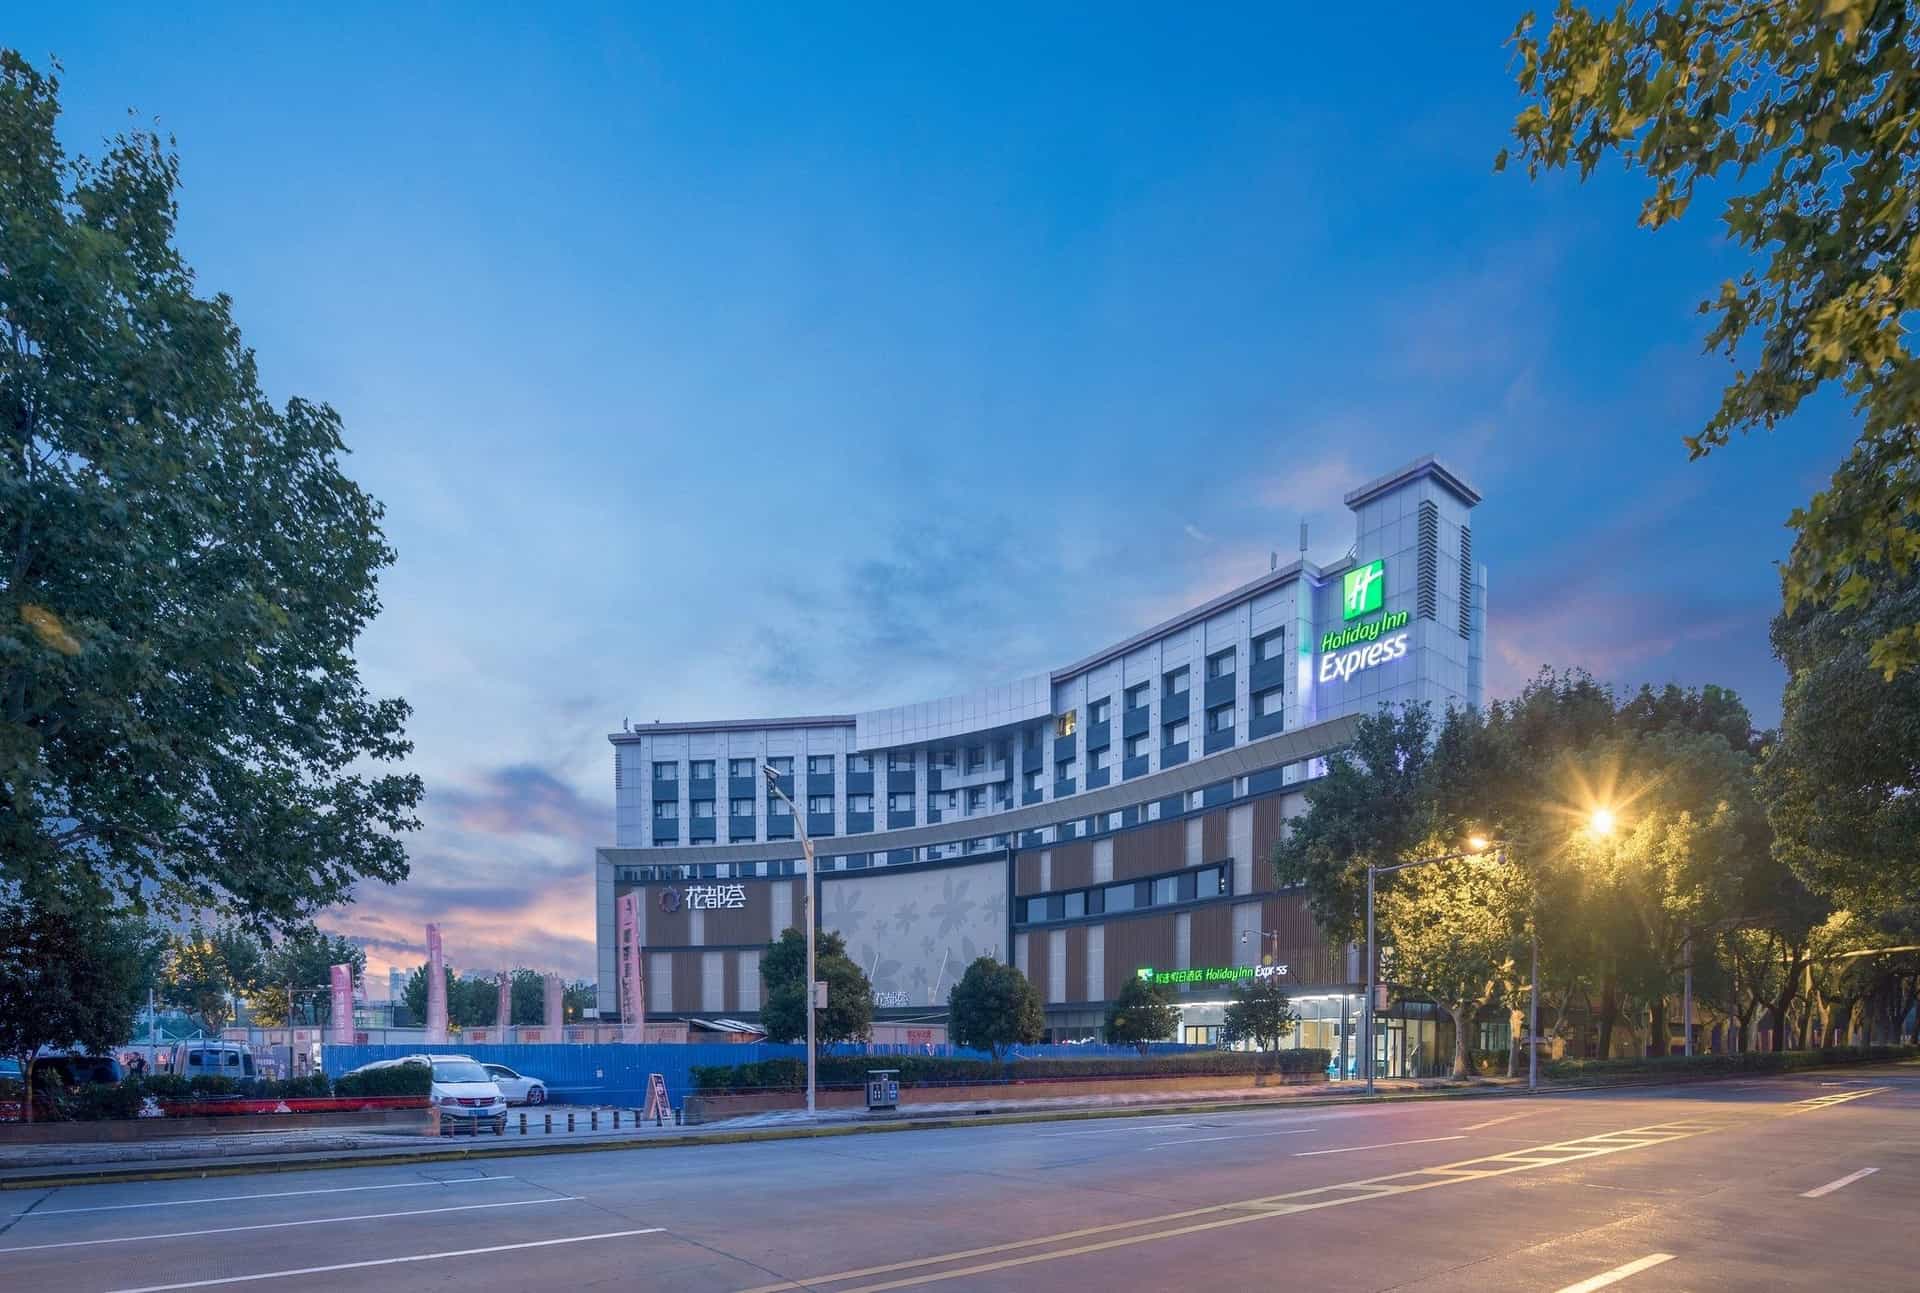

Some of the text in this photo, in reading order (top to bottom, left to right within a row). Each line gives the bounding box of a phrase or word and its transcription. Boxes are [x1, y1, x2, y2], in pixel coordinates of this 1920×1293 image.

[1321, 610, 1407, 652] Holiday Inn
[1319, 634, 1408, 682] Express
[684, 884, 746, 909] 花都荟
[1206, 967, 1238, 981] Holiday
[1238, 965, 1254, 977] Inn
[1255, 964, 1289, 979] Exprss
